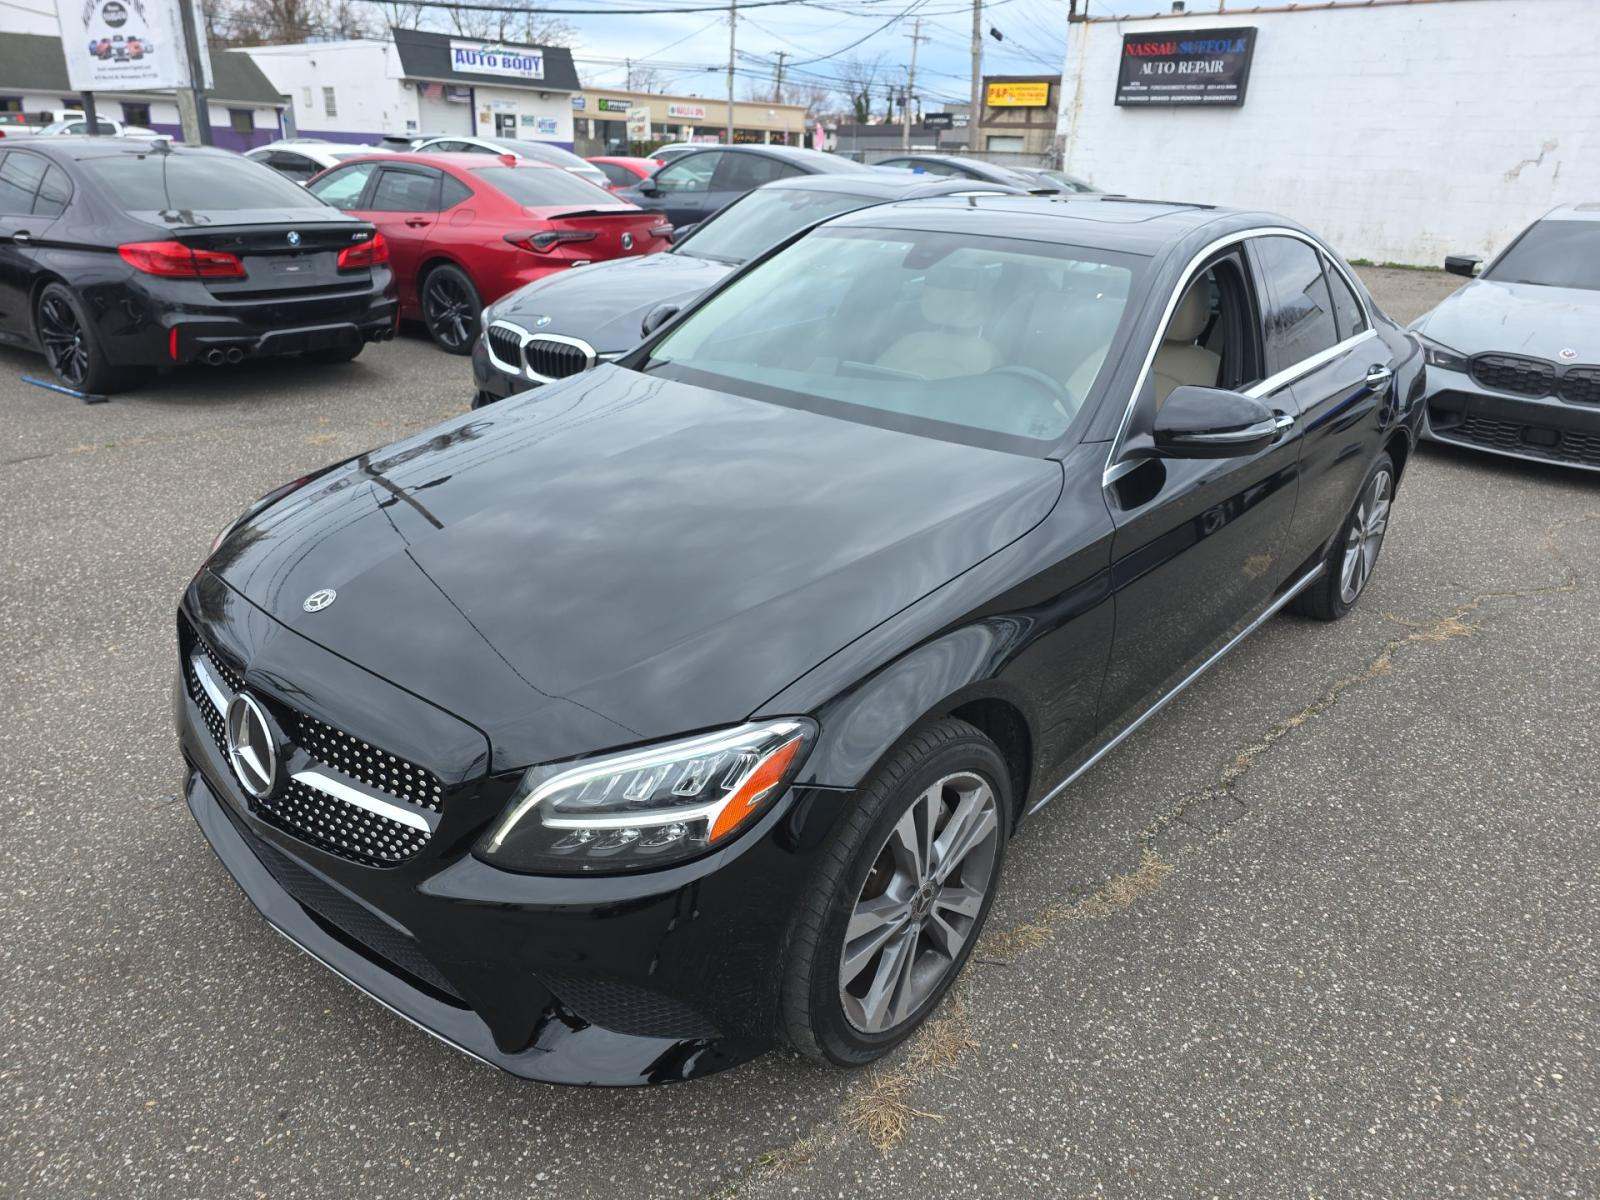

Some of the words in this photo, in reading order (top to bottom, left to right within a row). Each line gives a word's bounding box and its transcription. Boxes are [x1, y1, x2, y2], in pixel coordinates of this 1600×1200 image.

[1125, 41, 1177, 56] NASSAU
[1179, 38, 1246, 54] SUFFOLK
[455, 48, 498, 67] AUTO
[502, 55, 541, 71] BODY
[1139, 61, 1175, 74] AUTO
[1178, 60, 1224, 73] REPAIR
